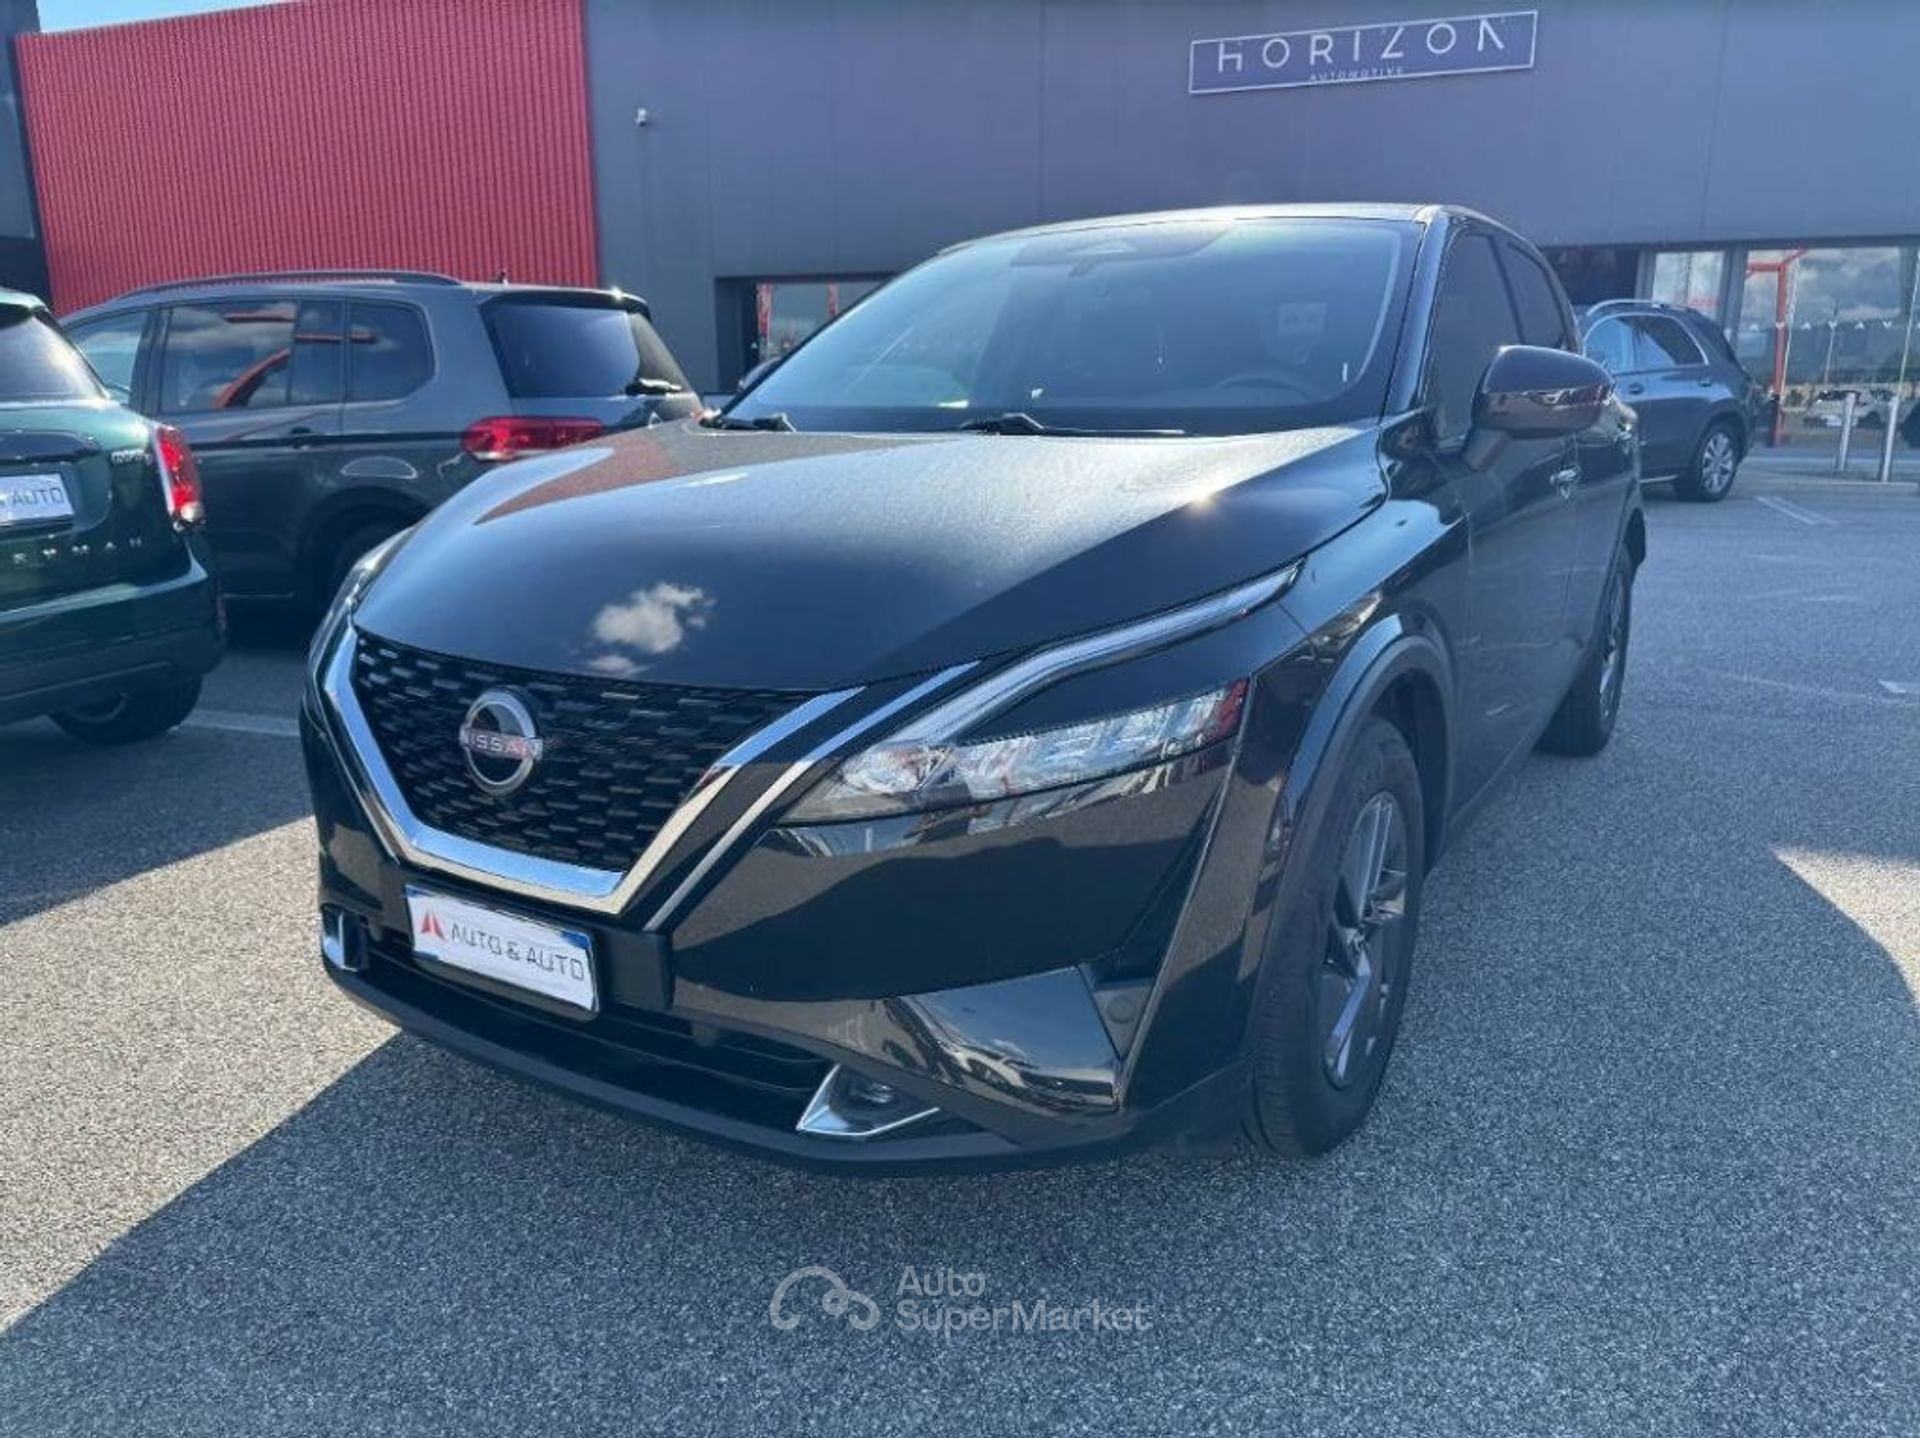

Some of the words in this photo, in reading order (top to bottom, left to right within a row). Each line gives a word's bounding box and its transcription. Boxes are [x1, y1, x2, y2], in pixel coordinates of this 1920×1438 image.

[1217, 18, 1505, 73] HORIZON
[12, 487, 65, 507] AUTO
[451, 923, 502, 956] AUTO
[503, 941, 520, 961] &
[527, 946, 585, 981] AUTO
